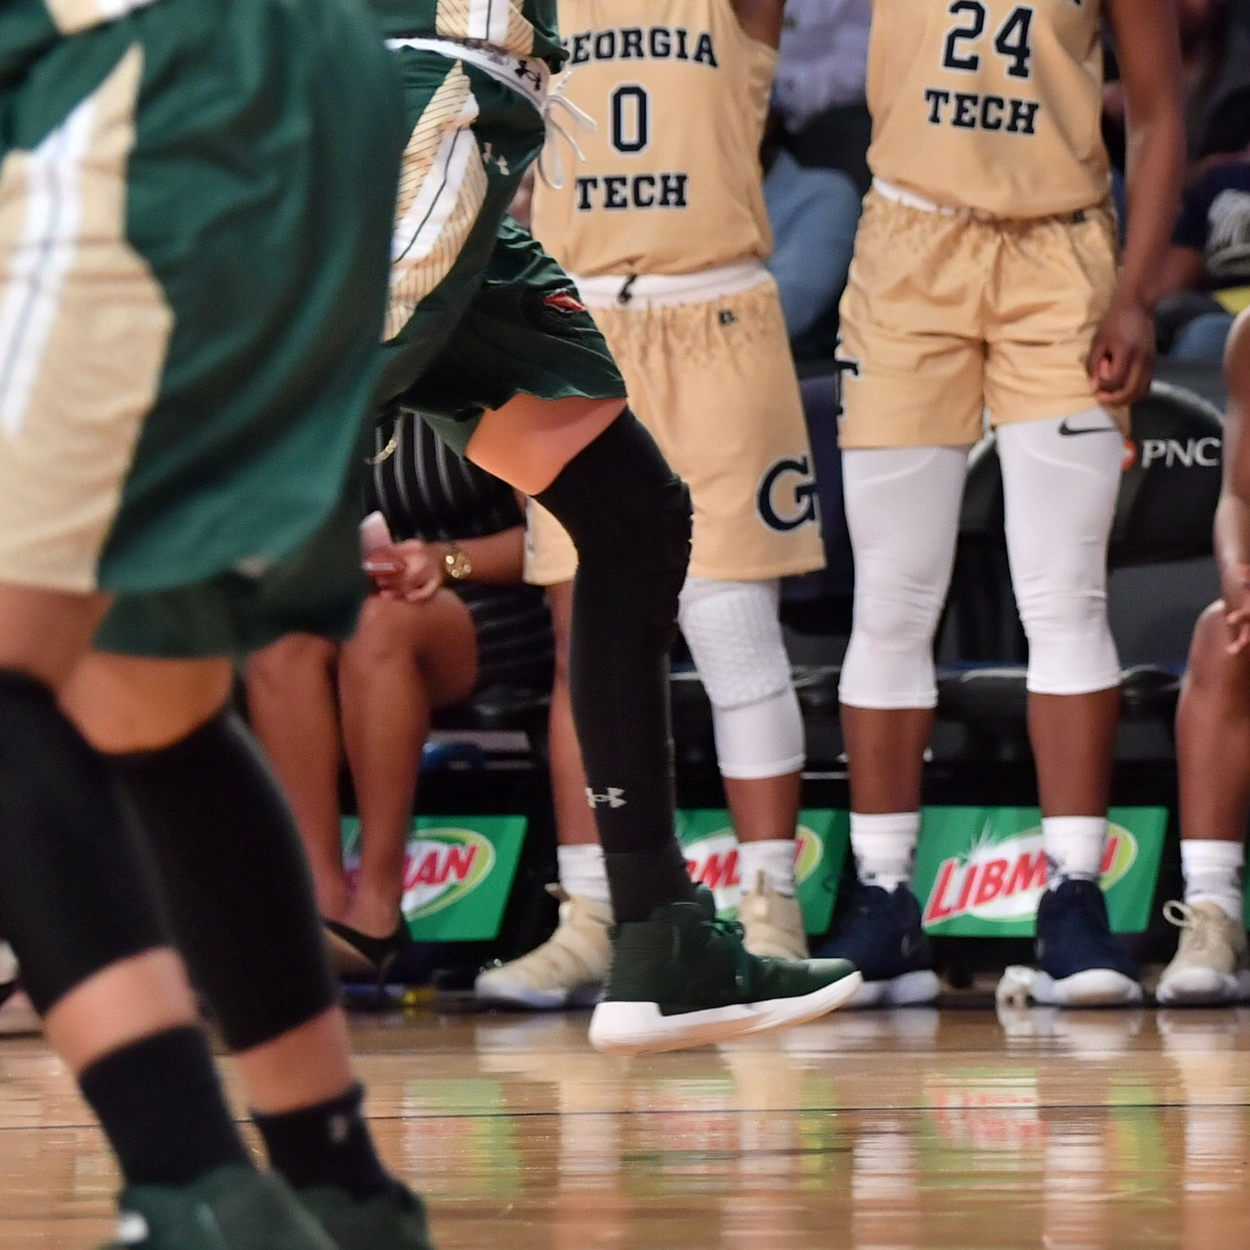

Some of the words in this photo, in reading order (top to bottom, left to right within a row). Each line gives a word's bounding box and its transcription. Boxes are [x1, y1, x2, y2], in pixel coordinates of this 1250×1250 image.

[563, 26, 720, 70] EORGIA
[611, 84, 650, 154] 0
[924, 88, 1040, 136] TECH
[574, 171, 689, 211] TECH
[1141, 436, 1222, 468] PNC
